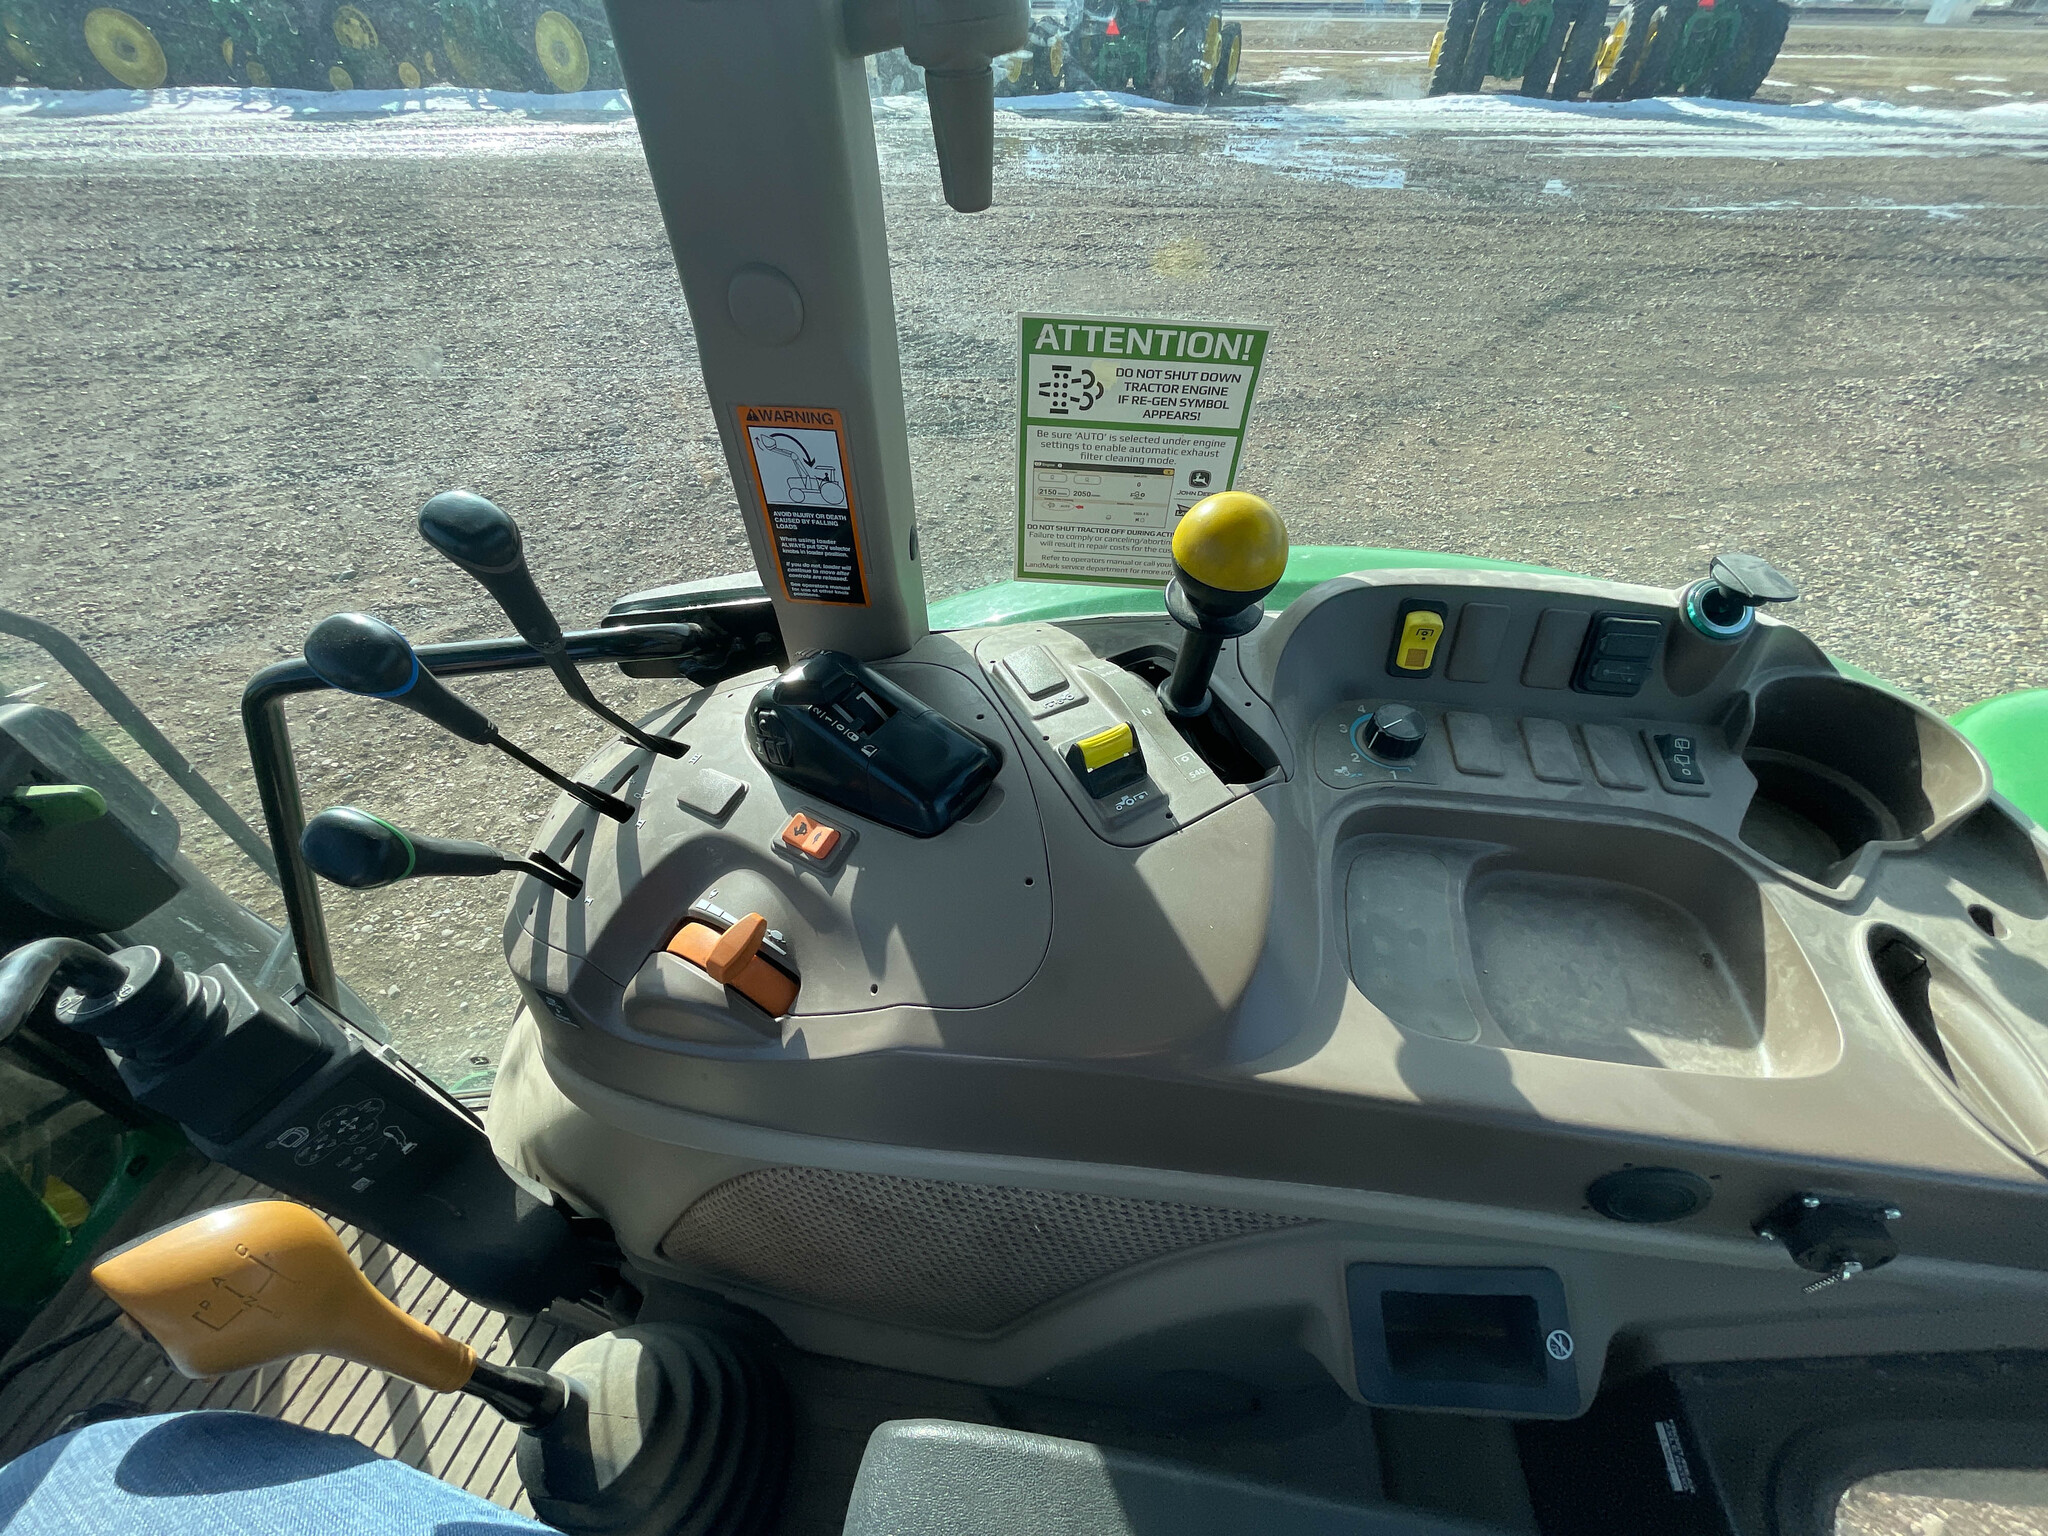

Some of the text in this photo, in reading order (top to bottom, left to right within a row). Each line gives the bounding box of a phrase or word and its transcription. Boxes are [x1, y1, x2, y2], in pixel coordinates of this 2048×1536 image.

[1035, 324, 1254, 360] ATTENTION!
[1116, 368, 1241, 383] DO NOT SHUT DOWN
[1125, 382, 1228, 396] TRACTOR ENGINE
[1118, 395, 1229, 409] IF RE-GEN SYMBOL
[758, 409, 834, 425] WARNING
[1143, 410, 1200, 421] APPEARS!
[1120, 435, 1160, 444] selected
[1163, 438, 1190, 446] under
[1193, 440, 1226, 448] engine
[1040, 440, 1219, 457] settings to enable automatic exhaust
[1080, 452, 1176, 465] filter cleaning mode.
[1066, 534, 1094, 543] comply
[1104, 536, 1172, 546] canceling/abortin
[1086, 543, 1108, 551] repair
[1071, 556, 1105, 565] operators
[1086, 565, 1128, 574] department
[1141, 708, 1153, 716] N
[1358, 704, 1366, 713] 4
[1339, 724, 1348, 733] 3
[1350, 753, 1360, 762] 2
[1188, 768, 1206, 780] 540
[1390, 770, 1398, 780] 1
[211, 1277, 226, 1288] A
[198, 1300, 211, 1311] P
[243, 1296, 258, 1307] N
